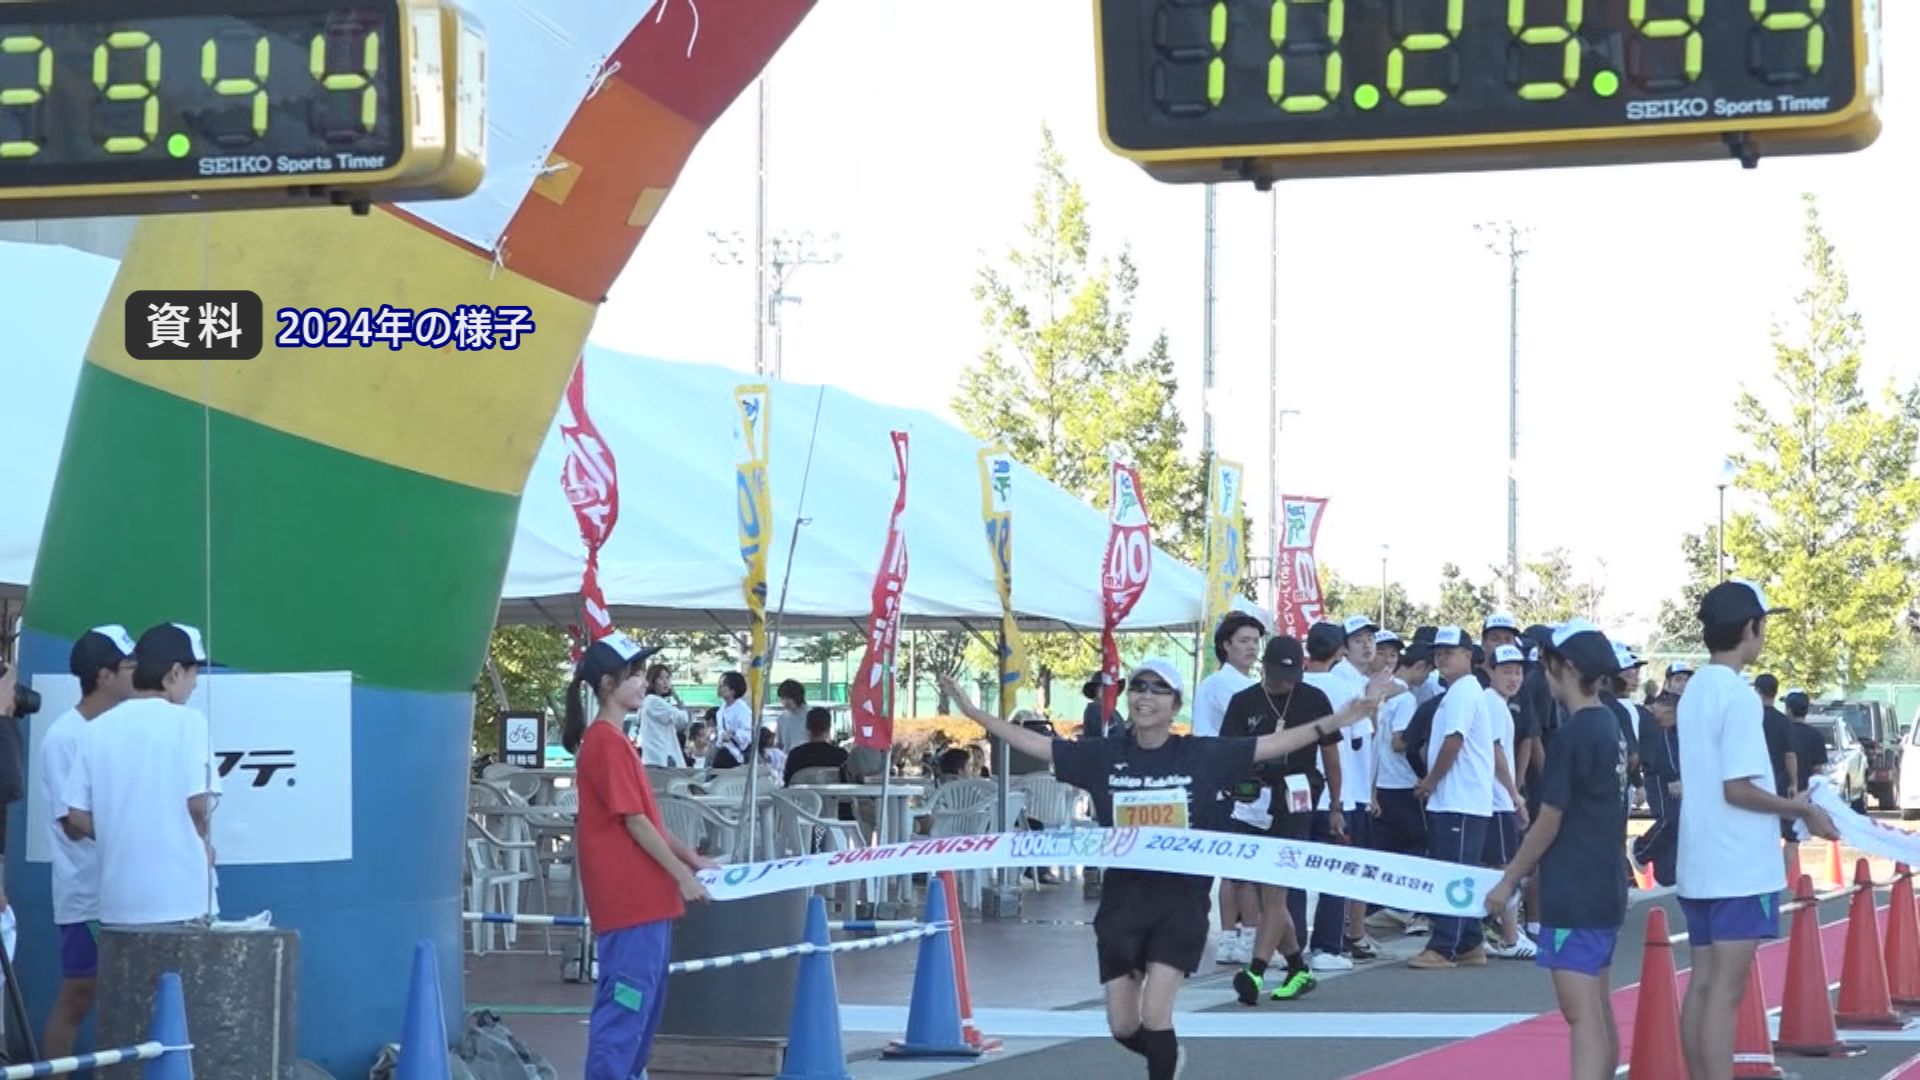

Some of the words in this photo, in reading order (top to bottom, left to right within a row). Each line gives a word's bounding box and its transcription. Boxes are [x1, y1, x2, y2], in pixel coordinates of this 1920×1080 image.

[1626, 98, 1708, 120] SEIKO
[1713, 98, 1773, 117] Sports
[1777, 94, 1831, 112] Timer
[199, 155, 272, 176] SEIKO
[277, 155, 332, 174] Sports
[336, 151, 386, 169] Timer
[1125, 804, 1175, 826] 7002
[901, 835, 1001, 857] FINISH
[1145, 834, 1260, 860] 2024.10.13
